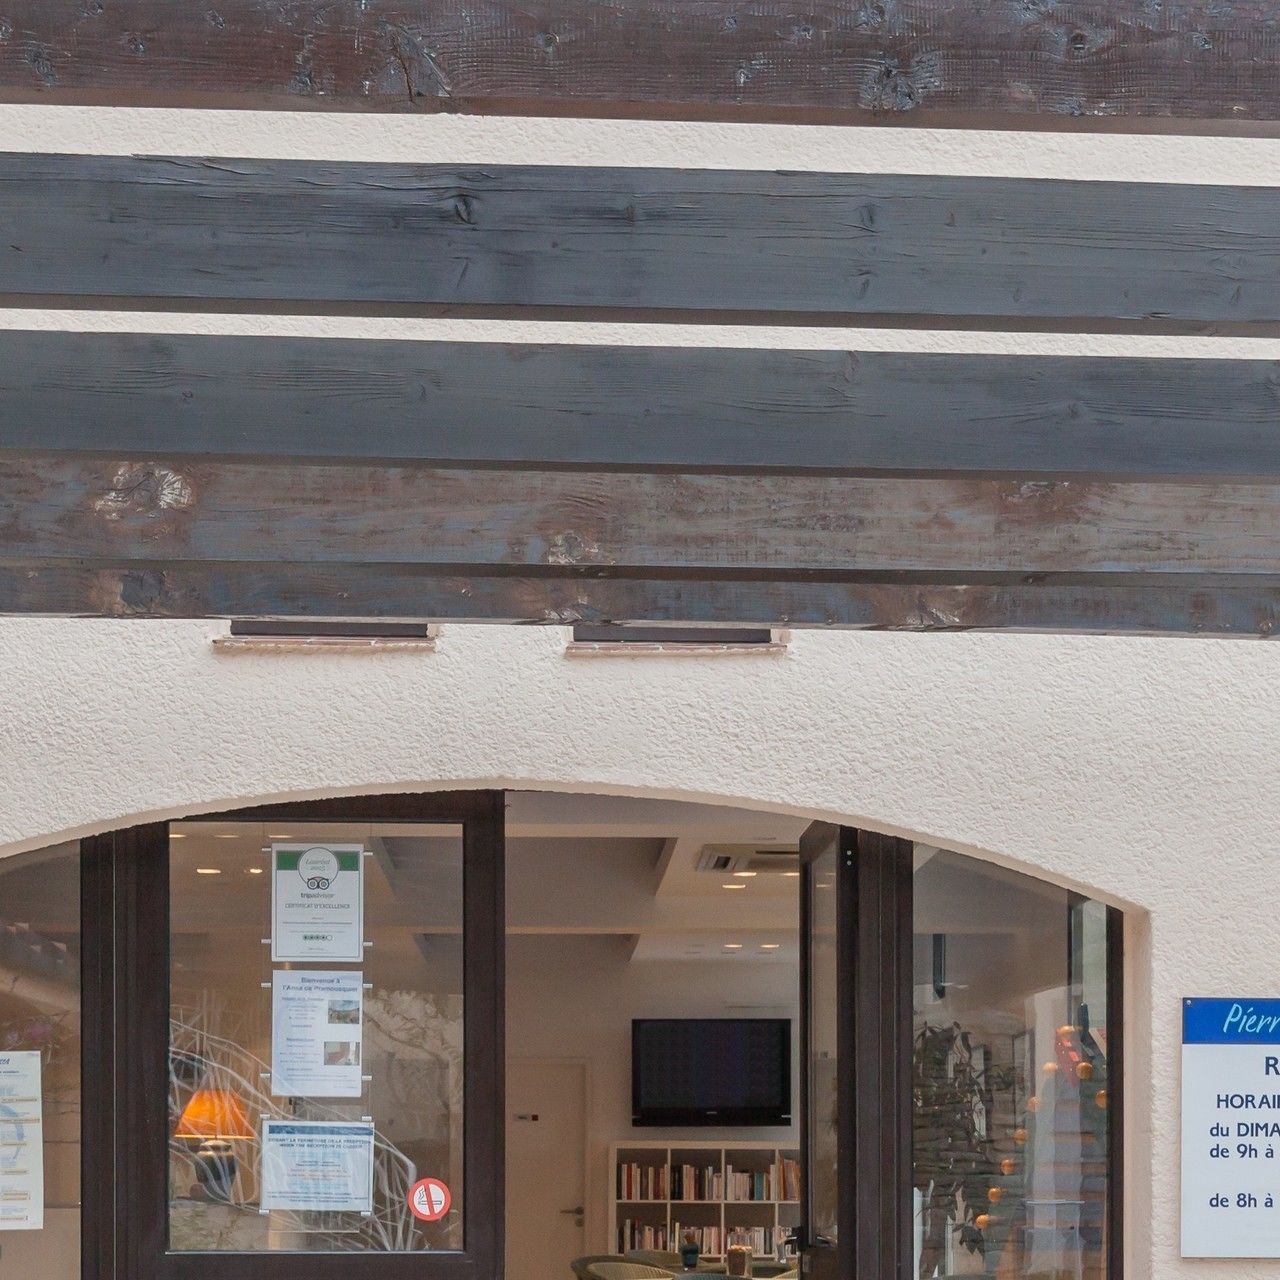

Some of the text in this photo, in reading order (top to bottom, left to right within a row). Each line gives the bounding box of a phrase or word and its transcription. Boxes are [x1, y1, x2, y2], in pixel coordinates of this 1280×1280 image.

[1209, 1122, 1230, 1138] du
[1209, 1143, 1230, 1159] de
[1236, 1143, 1258, 1159] 9h
[1265, 1144, 1274, 1159] à
[1209, 1193, 1230, 1208] de
[1236, 1192, 1258, 1208] 8h
[1264, 1193, 1274, 1208] à
